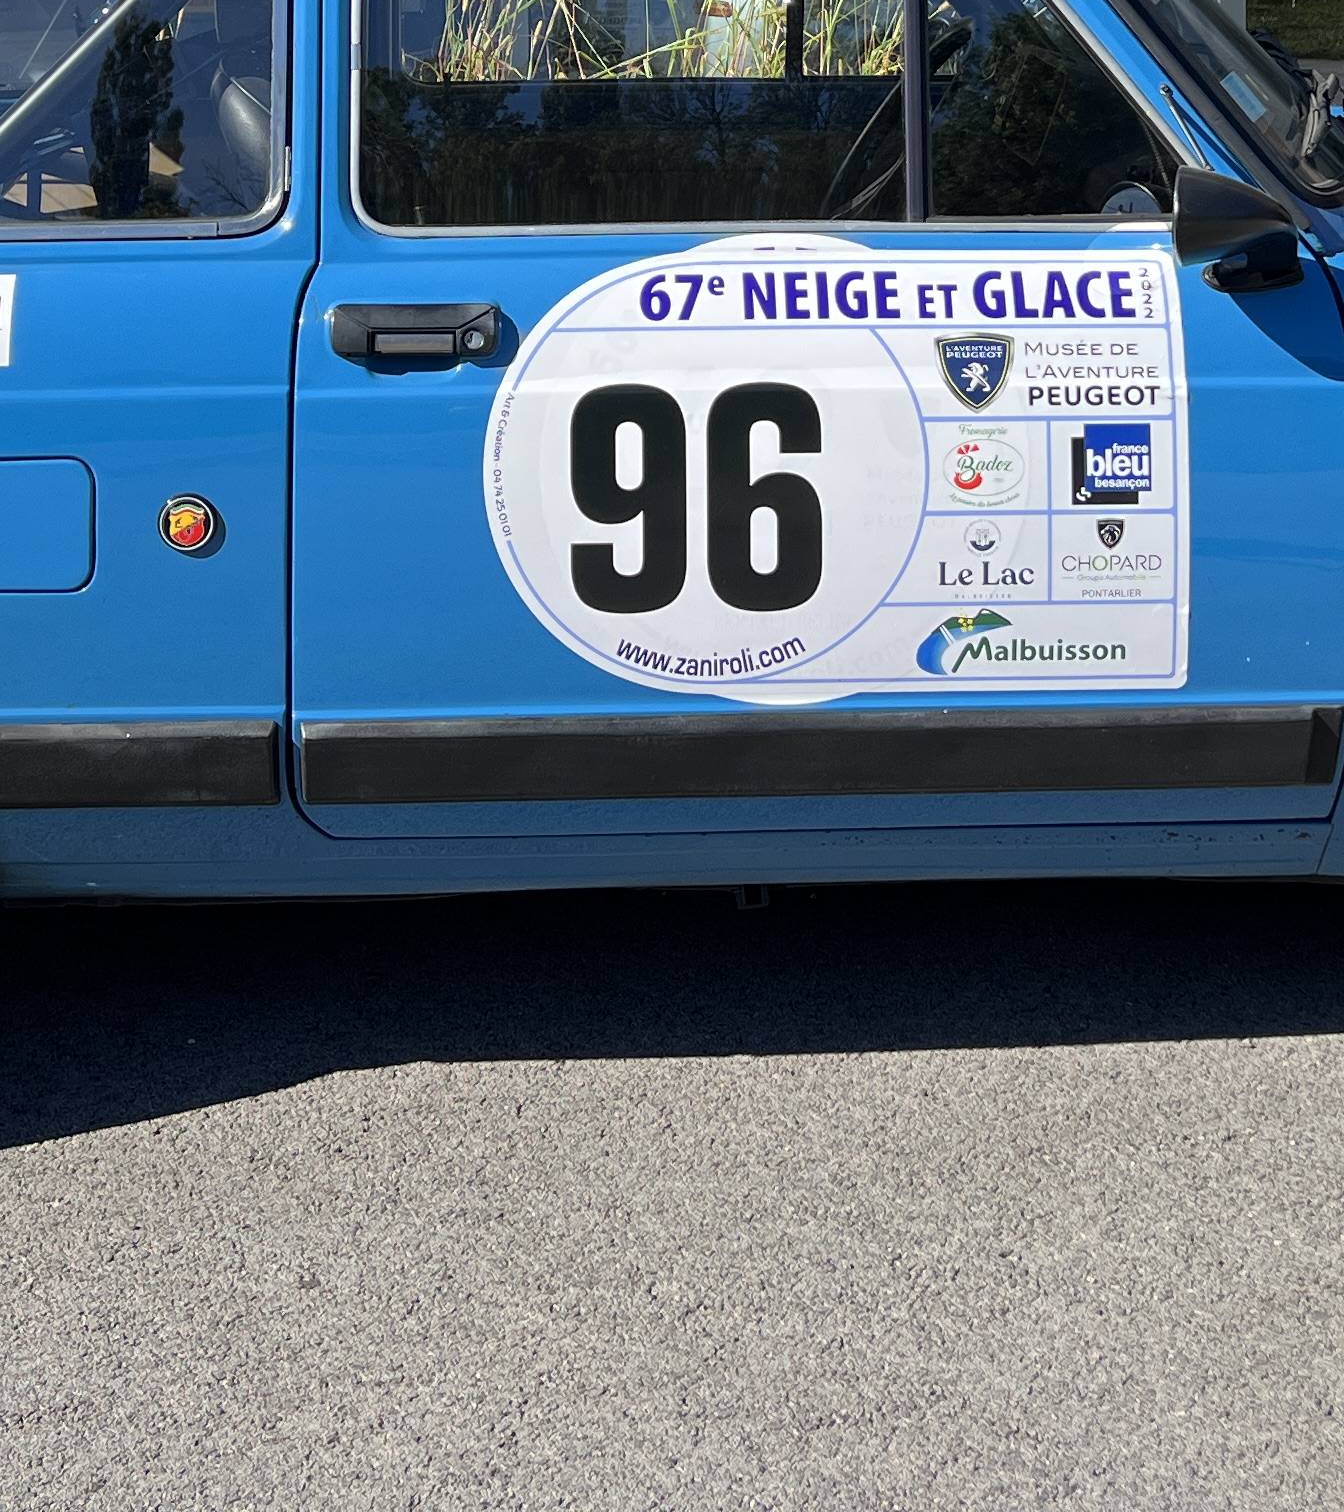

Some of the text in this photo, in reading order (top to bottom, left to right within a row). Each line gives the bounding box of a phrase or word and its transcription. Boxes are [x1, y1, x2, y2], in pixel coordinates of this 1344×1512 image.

[743, 270, 901, 319] NEIGE
[917, 284, 958, 318] ET
[972, 270, 1136, 319] GLACE
[946, 351, 1003, 359] PEUGEOT
[1024, 340, 1138, 356] MUSÉE DE
[1025, 365, 1159, 379] L'AVENTURE
[1028, 385, 1161, 407] PEUGEOT
[1112, 442, 1149, 454] france
[957, 455, 1014, 482] Badoz
[1086, 448, 1150, 476] bleu
[1094, 476, 1150, 489] besançon
[570, 382, 823, 613] 96
[939, 560, 1035, 587] Le Lac
[1061, 554, 1163, 572] CHOPARD
[1081, 588, 1143, 598] PONTARLIER
[616, 637, 807, 677] www.zaniroli.com
[951, 635, 1127, 673] Malbuisson
